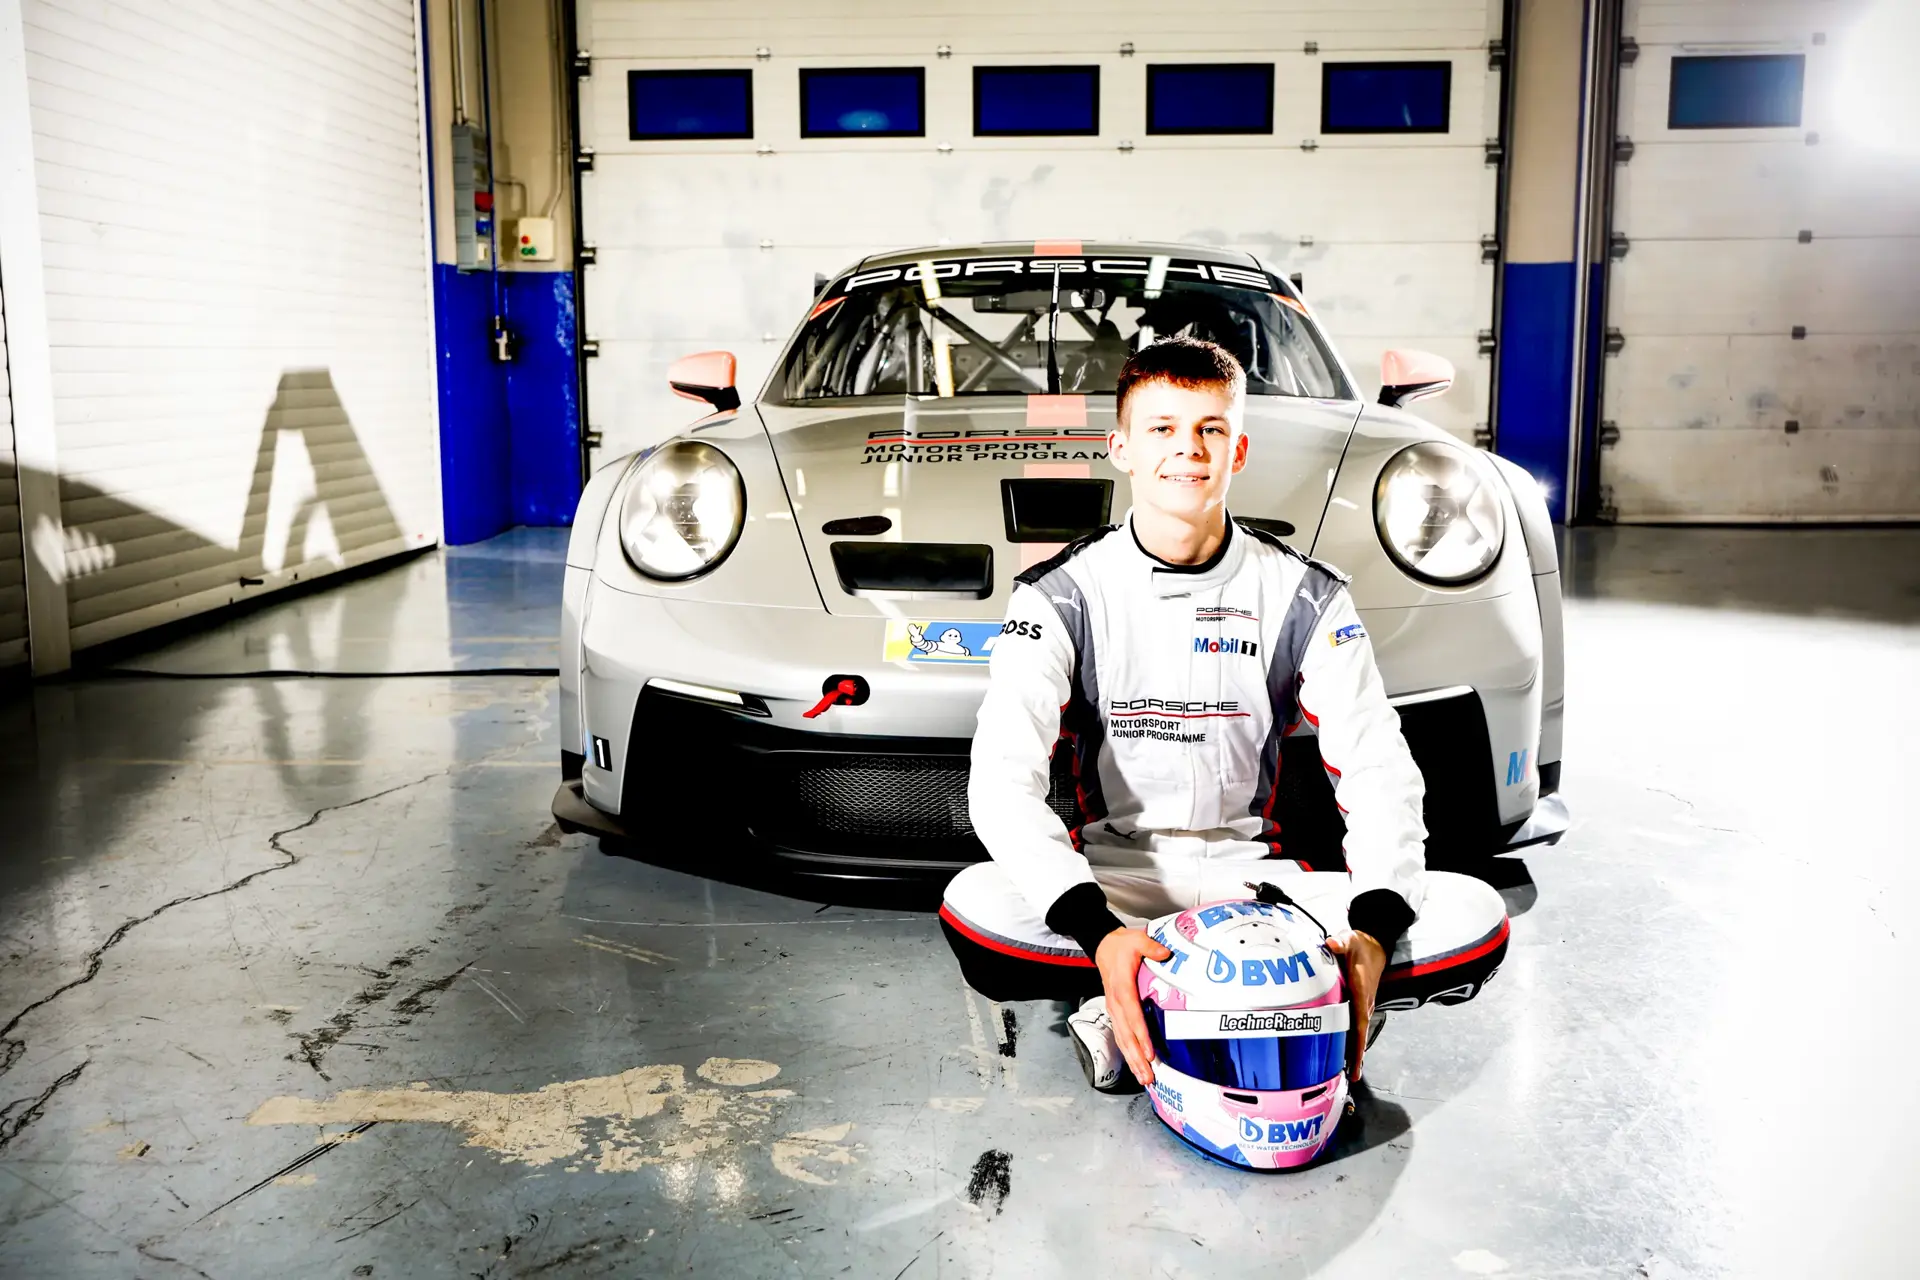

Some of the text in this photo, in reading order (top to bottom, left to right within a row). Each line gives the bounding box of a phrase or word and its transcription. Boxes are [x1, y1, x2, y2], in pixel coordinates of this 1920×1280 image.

[844, 260, 1271, 292] PORSCHE
[868, 429, 1113, 440] PORSC
[864, 442, 1056, 455] MOTORSPORT
[860, 453, 963, 464] JUNIOR
[1196, 606, 1252, 616] PORSCHE
[1194, 637, 1239, 653] Mobil
[1111, 698, 1239, 712] PORSCHE
[1111, 719, 1181, 731] MOTORSPORT
[1112, 729, 1206, 743] JUNIOR PROGRAMME
[1242, 951, 1316, 986] BWT
[1153, 1080, 1183, 1103] HANGE
[1157, 1091, 1184, 1112] WORLD
[1268, 1114, 1324, 1143] BWT
[1281, 1138, 1320, 1150] TECHNOLOGY
